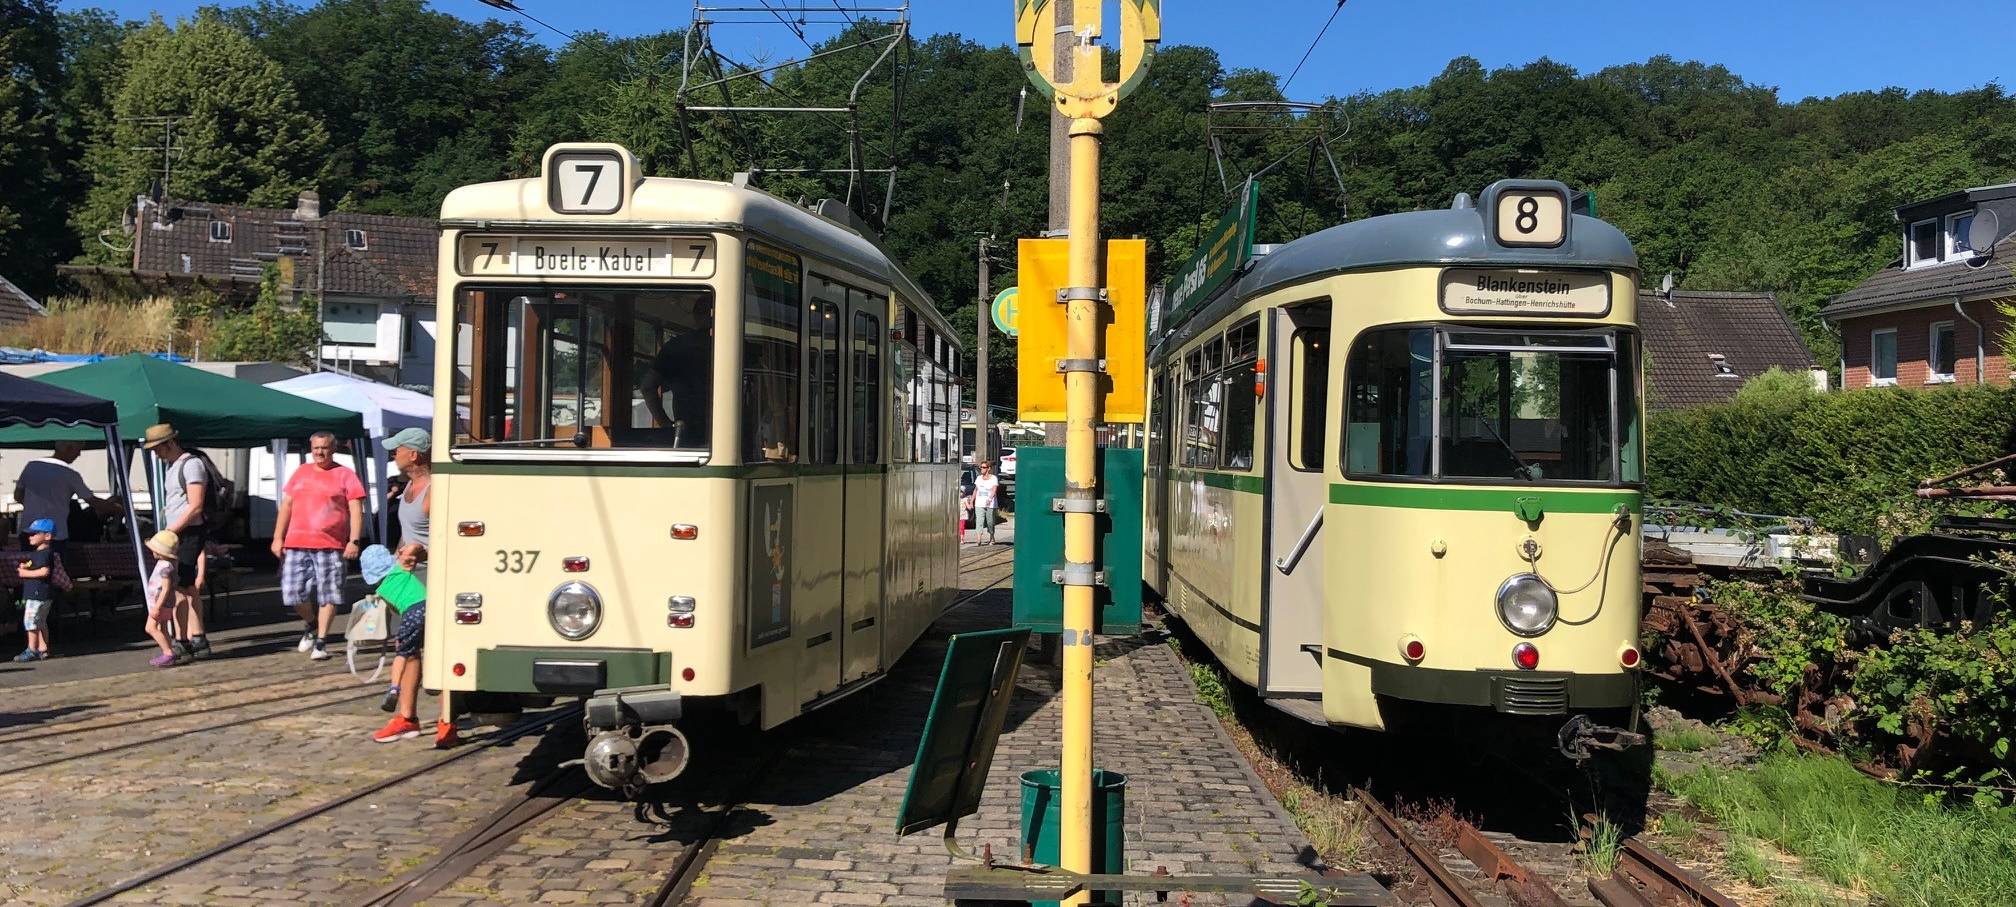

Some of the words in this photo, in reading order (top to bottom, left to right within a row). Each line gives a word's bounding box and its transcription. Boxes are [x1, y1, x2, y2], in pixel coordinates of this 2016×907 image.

[575, 164, 604, 206] 7
[1515, 196, 1538, 234] 8
[481, 242, 499, 270] 7
[535, 246, 652, 271] Boele-Kabel
[689, 244, 707, 273] 7
[1476, 275, 1571, 295] Blankenstein
[494, 549, 541, 574] 337
